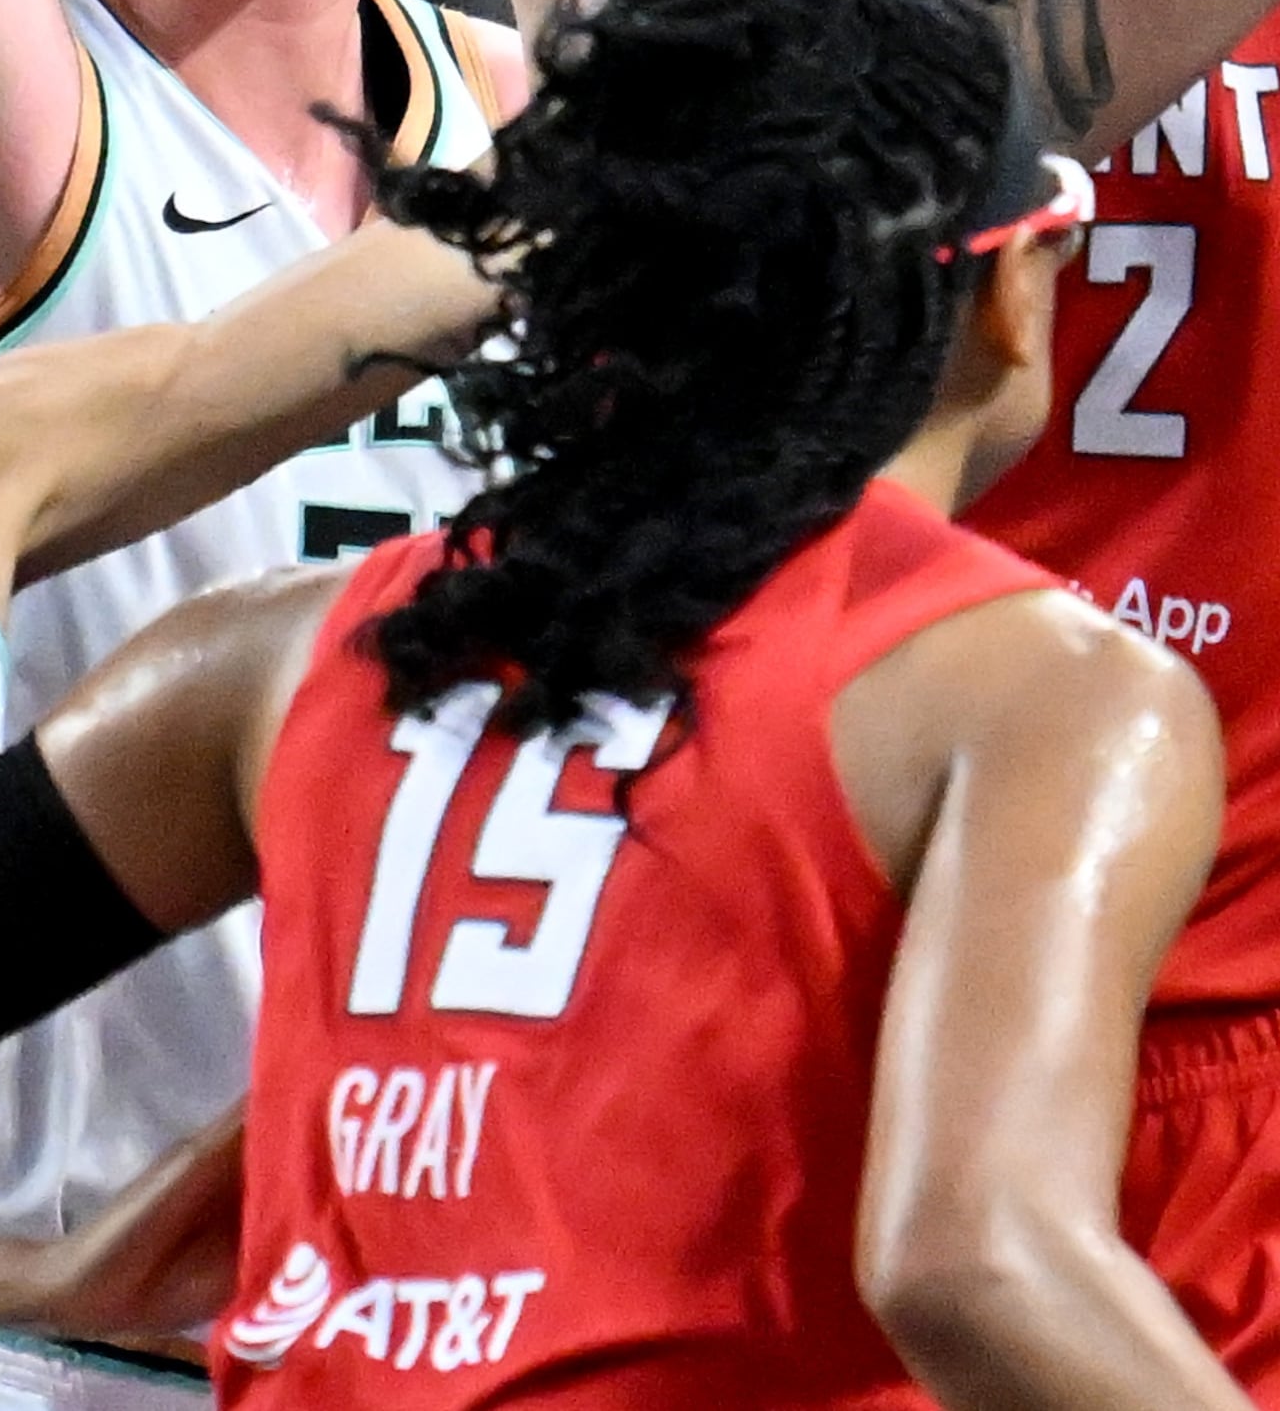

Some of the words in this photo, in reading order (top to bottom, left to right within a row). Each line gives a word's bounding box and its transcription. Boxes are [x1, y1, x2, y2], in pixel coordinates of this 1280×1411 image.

[1110, 576, 1232, 655] App
[347, 679, 678, 1019] 15
[327, 1057, 499, 1200] GRAY
[314, 1267, 548, 1373] AT&T
